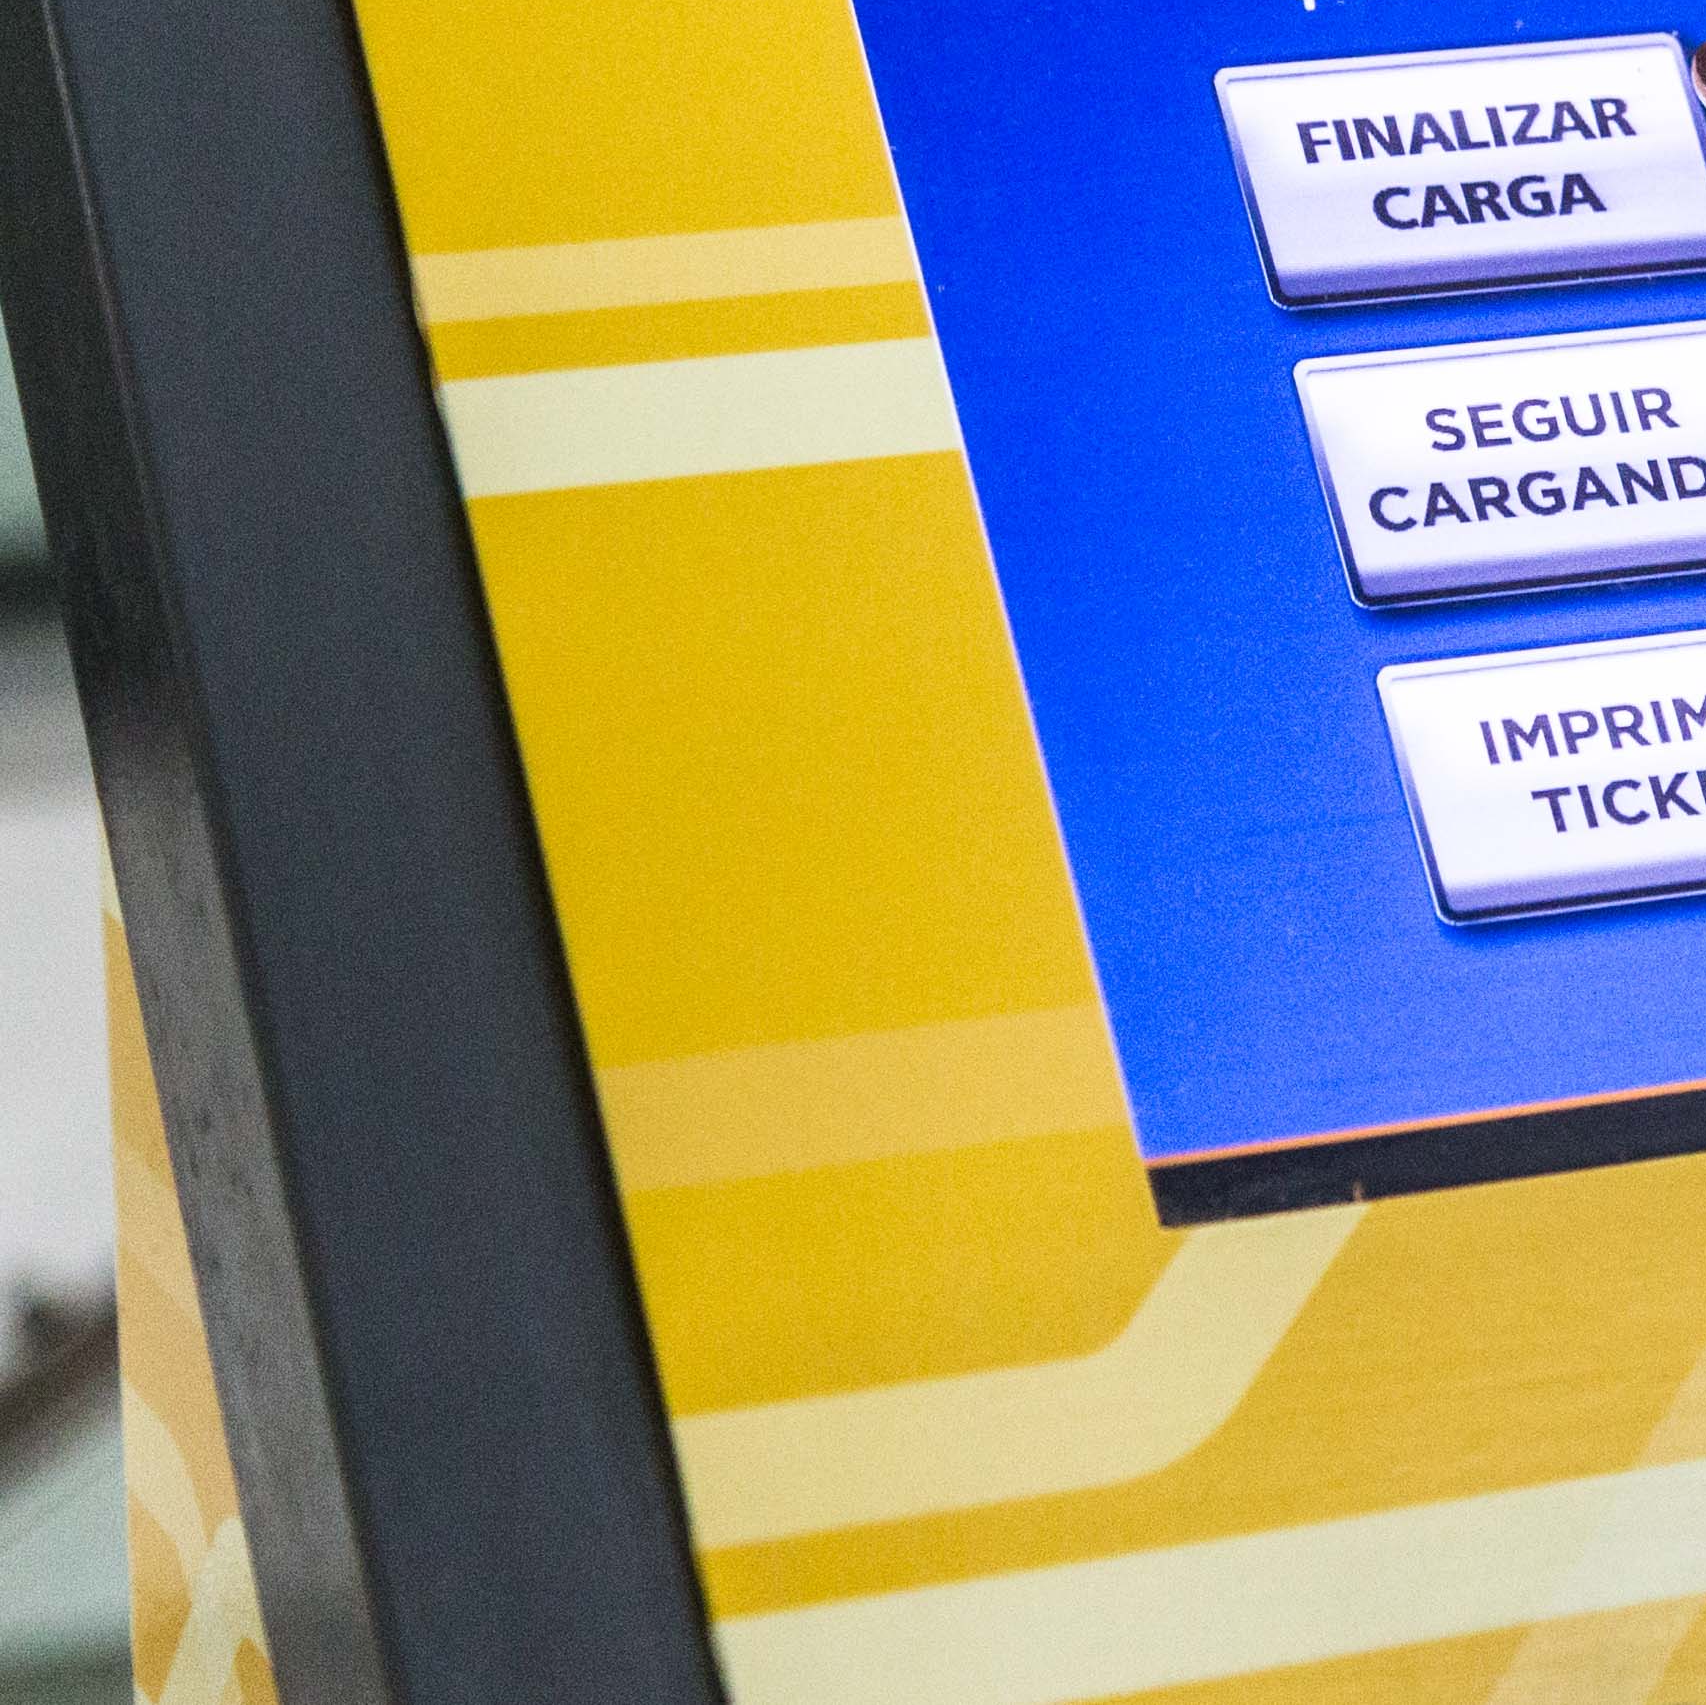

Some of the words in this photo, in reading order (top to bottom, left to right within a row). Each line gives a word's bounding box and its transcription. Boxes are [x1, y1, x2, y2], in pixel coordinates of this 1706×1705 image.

[1295, 95, 1638, 165] FINALIZAR
[1372, 171, 1607, 231] CARGA
[1423, 386, 1681, 452] SEGUIR
